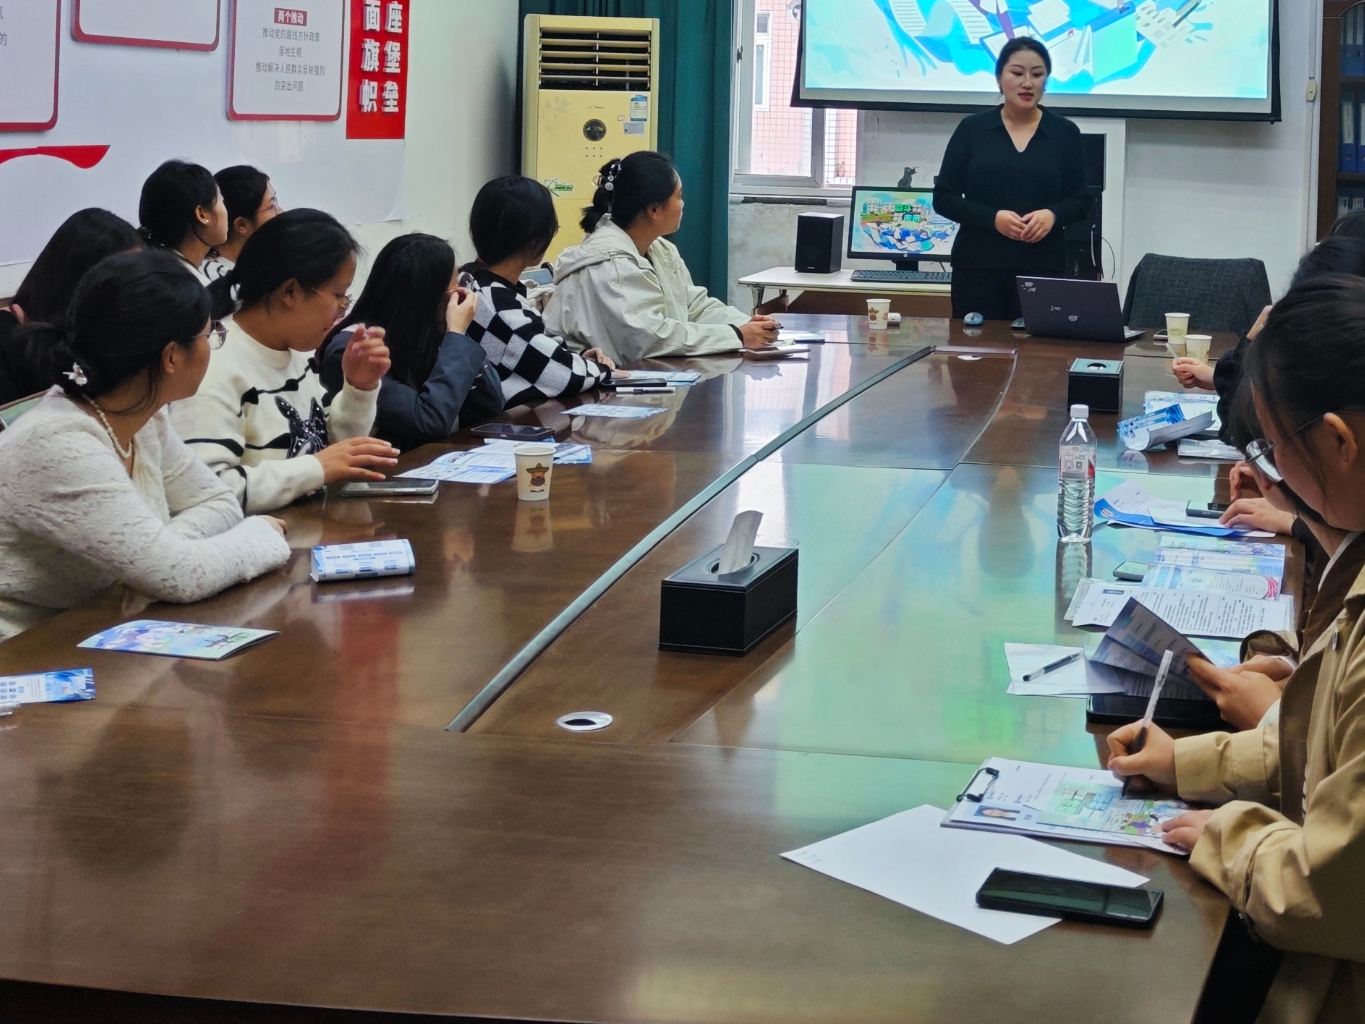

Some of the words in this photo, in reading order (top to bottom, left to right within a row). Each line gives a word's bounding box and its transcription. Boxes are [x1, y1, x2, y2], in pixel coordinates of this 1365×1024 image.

[278, 10, 304, 25] 两个推动
[262, 27, 320, 42] 推动党的路线方针政策
[279, 46, 302, 58] 落地生根
[255, 62, 325, 76] 推动解决人民群众反映强烈
[274, 80, 304, 92] 的突出问题
